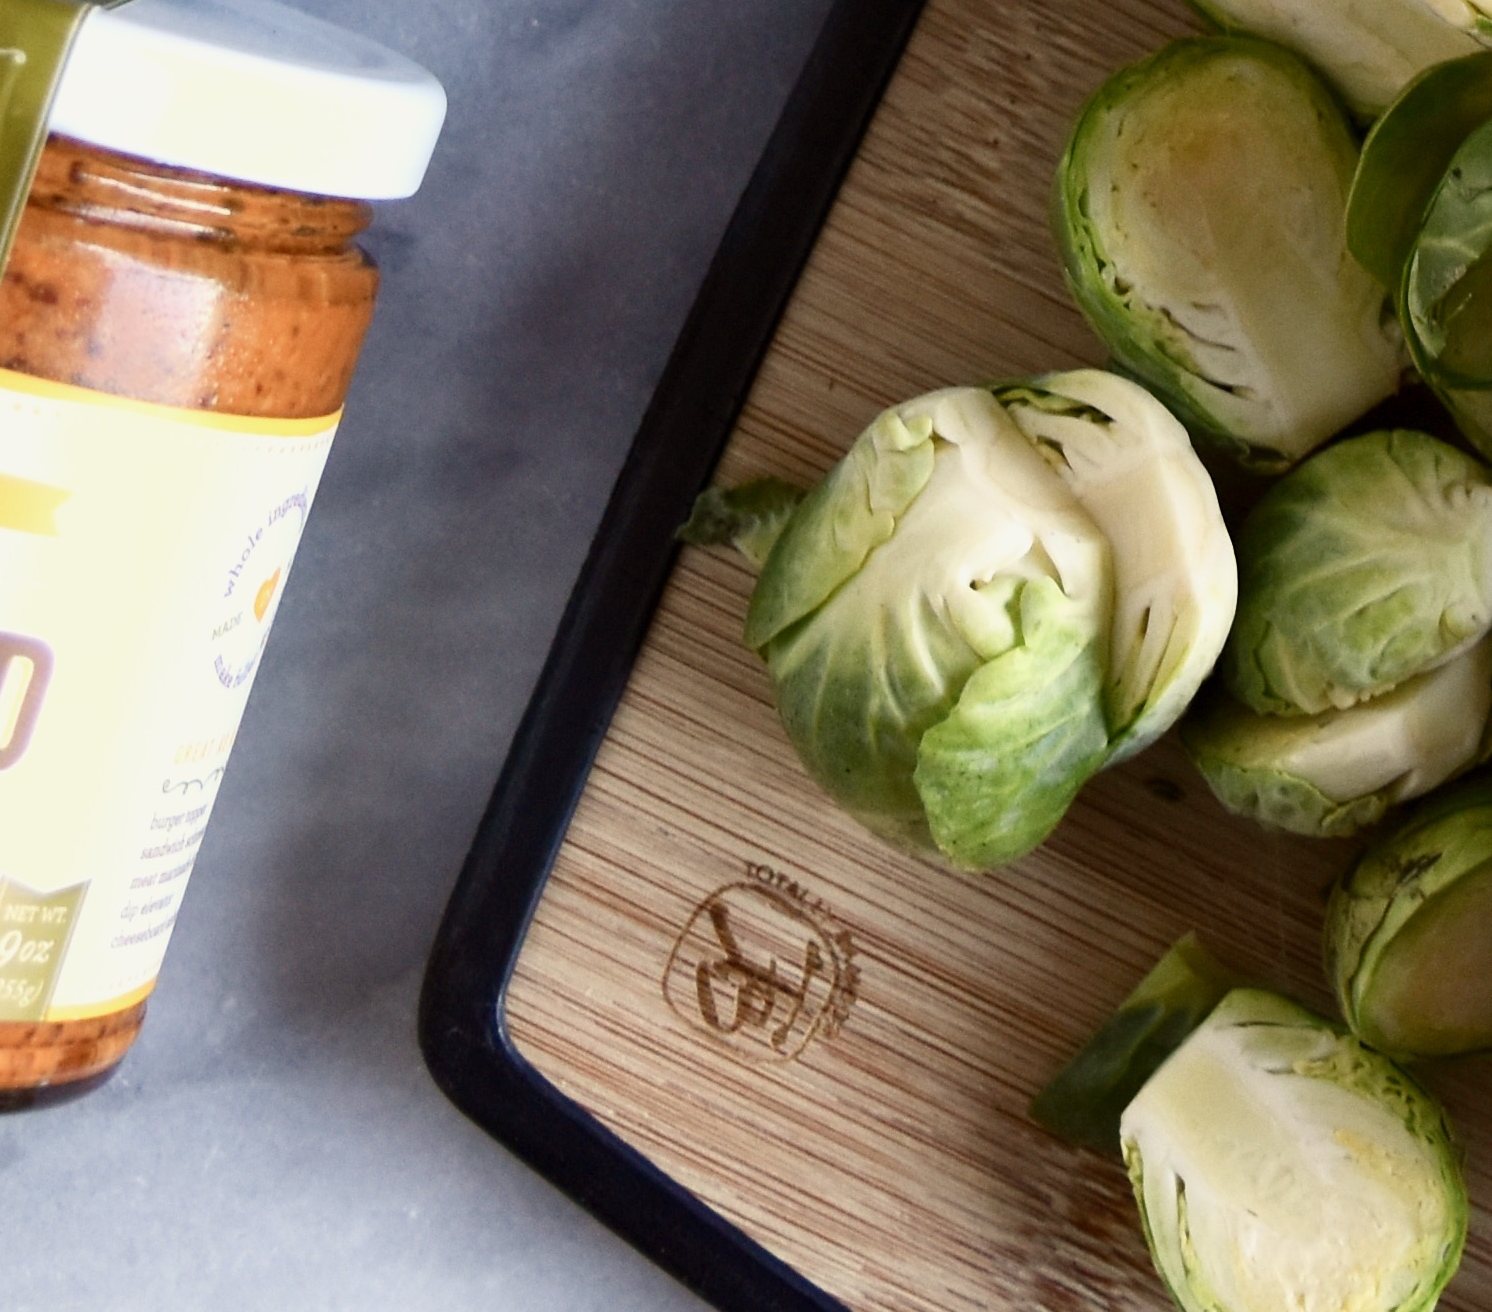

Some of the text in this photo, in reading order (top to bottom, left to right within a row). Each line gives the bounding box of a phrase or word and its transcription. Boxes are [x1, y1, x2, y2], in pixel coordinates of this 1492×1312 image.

[223, 526, 264, 599] whole
[3, 903, 68, 924] NET WT.
